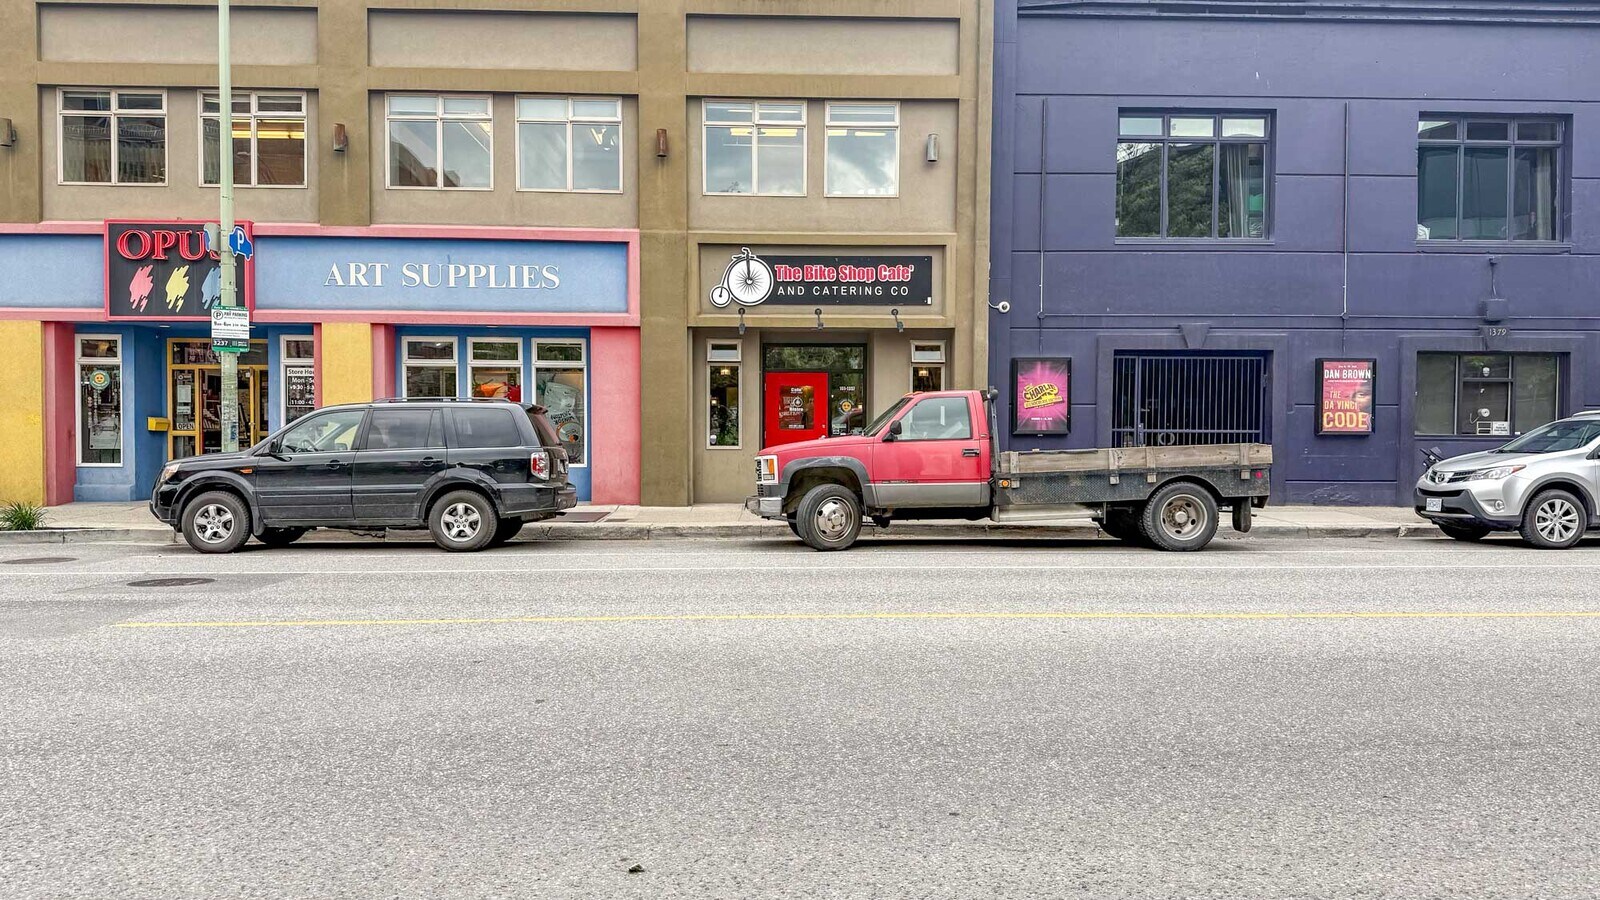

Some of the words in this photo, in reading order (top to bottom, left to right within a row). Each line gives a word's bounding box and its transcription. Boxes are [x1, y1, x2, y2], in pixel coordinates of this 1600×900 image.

[116, 229, 220, 261] OPU
[237, 229, 244, 250] P
[323, 262, 389, 287] ART
[401, 263, 561, 289] SUPPLIES
[775, 264, 802, 282] The
[803, 264, 837, 282] Bike
[838, 264, 875, 283] Shop
[777, 285, 805, 296] AND
[813, 286, 883, 296] CATERING
[890, 286, 910, 296] CO
[1489, 327, 1507, 336] 1379
[1324, 369, 1340, 379] DAN
[1342, 369, 1371, 379] BROWN
[1330, 390, 1341, 399] THE
[1324, 400, 1334, 410] DA
[1337, 400, 1359, 410] VINCI
[1323, 411, 1368, 428] CODE
